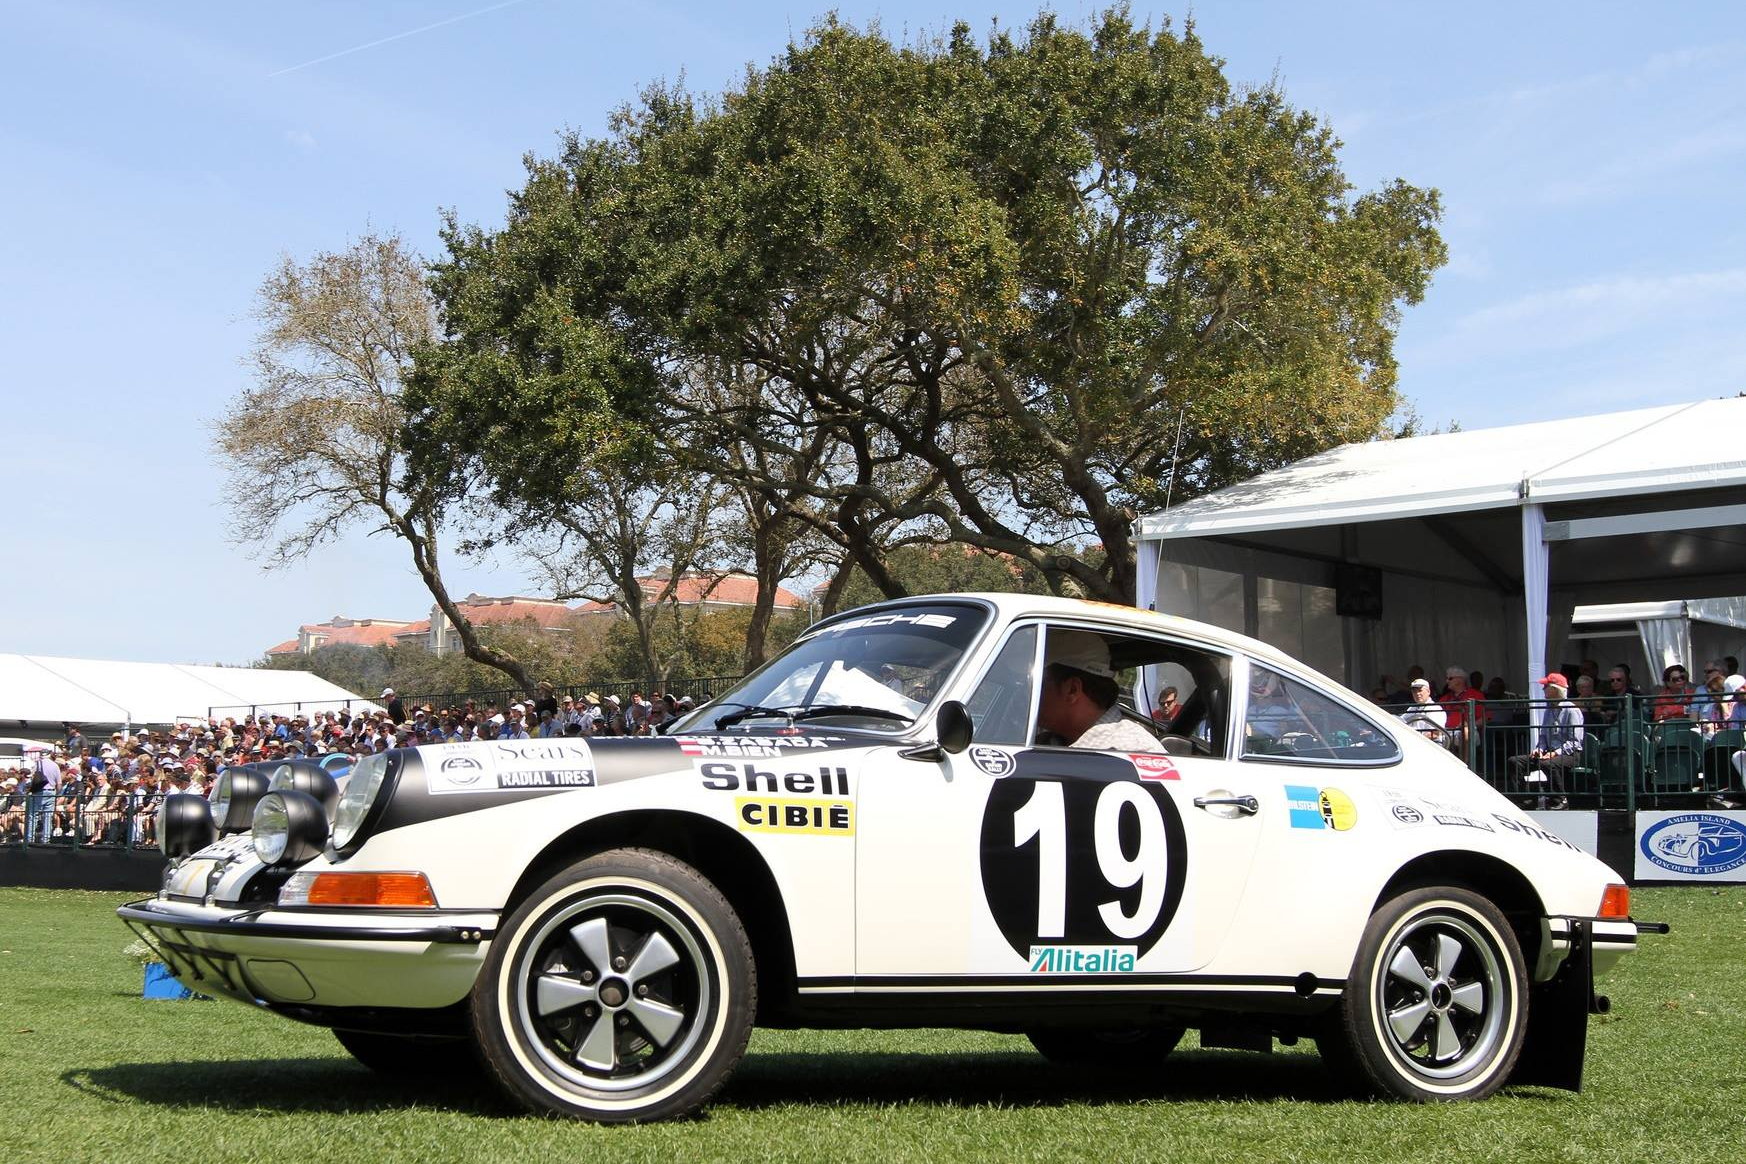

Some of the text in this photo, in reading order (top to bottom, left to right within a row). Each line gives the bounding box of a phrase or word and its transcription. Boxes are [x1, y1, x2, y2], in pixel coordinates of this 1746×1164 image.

[498, 743, 584, 760] Sears
[703, 746, 782, 757] M.BIEN
[502, 770, 590, 786] RADIAL TIRES
[700, 763, 849, 795] Shell
[1667, 815, 1731, 825] AMELIA ISLAND
[1014, 781, 1168, 939] 19
[1650, 856, 1693, 873] CONCOURS
[1031, 948, 1134, 971] Alitalia
